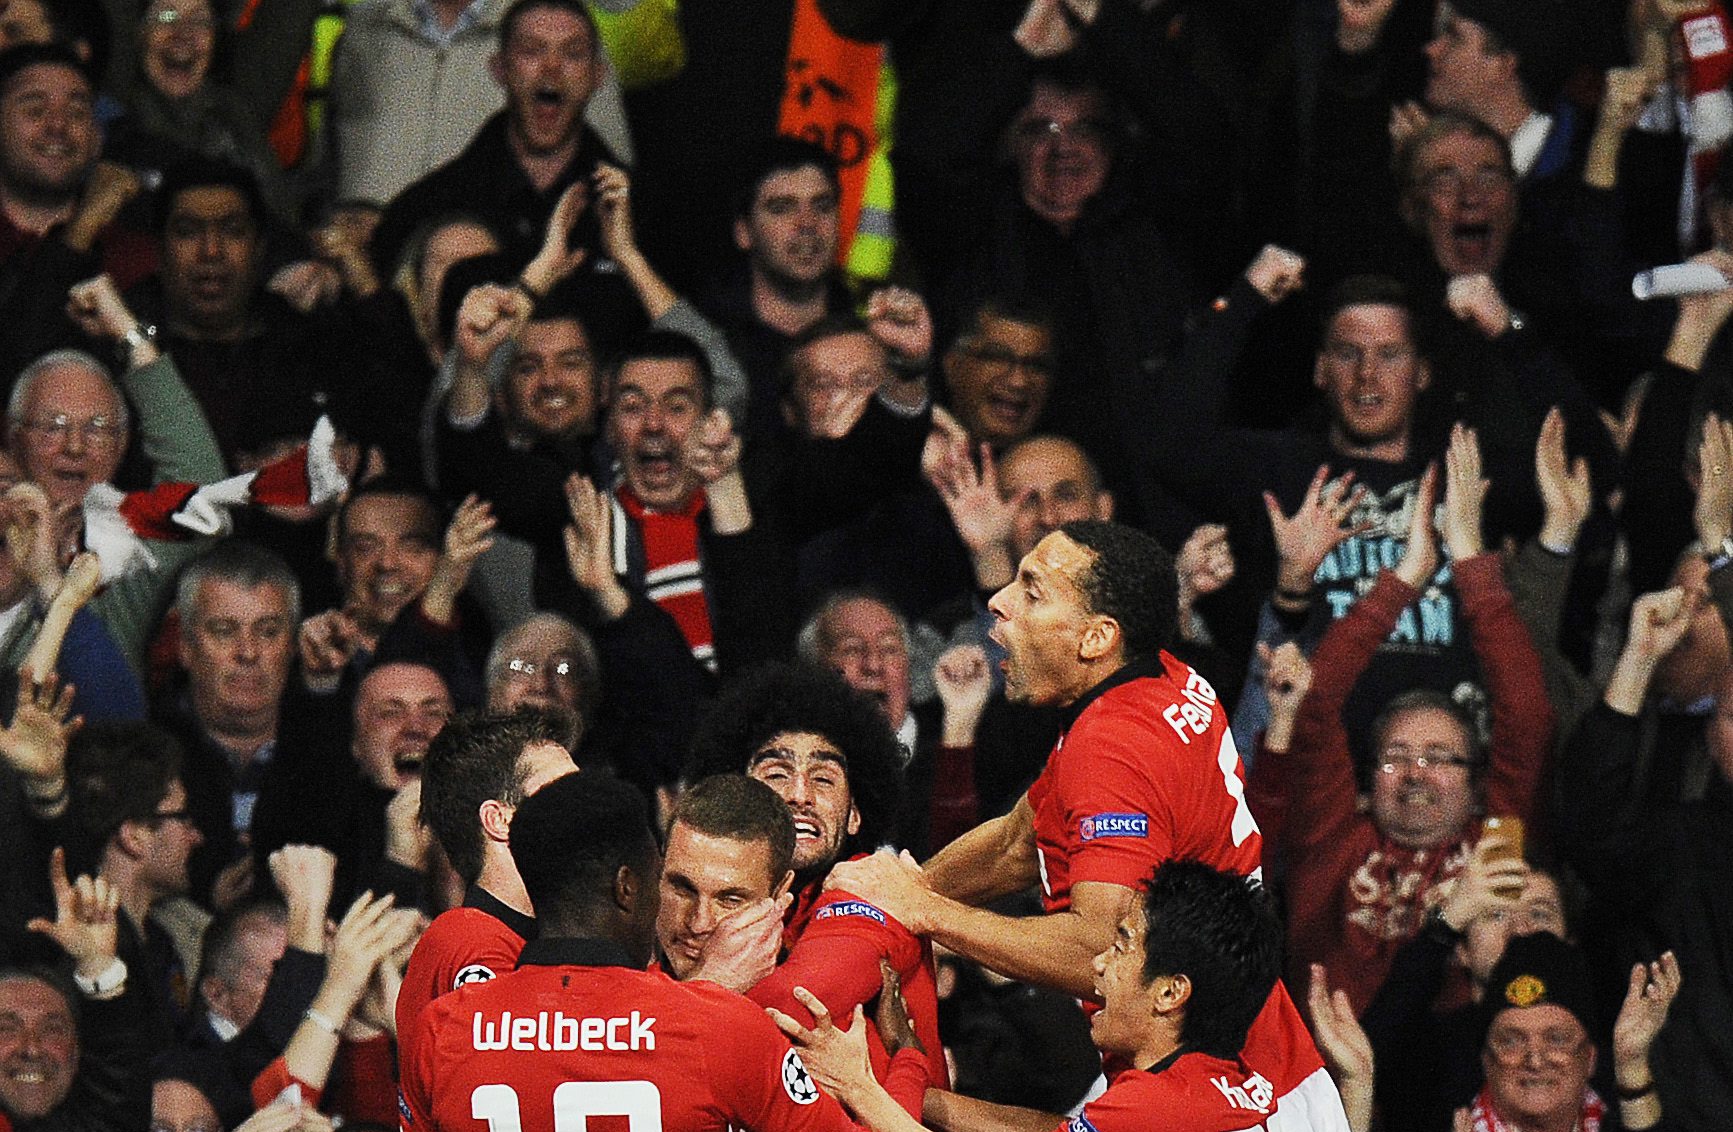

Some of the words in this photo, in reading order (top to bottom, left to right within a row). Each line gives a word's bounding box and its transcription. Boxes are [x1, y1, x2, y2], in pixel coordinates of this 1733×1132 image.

[1326, 588, 1454, 645] TAM
[1095, 817, 1148, 833] RESPECT
[835, 903, 885, 922] RESPECT
[472, 1010, 657, 1051] Welbeck
